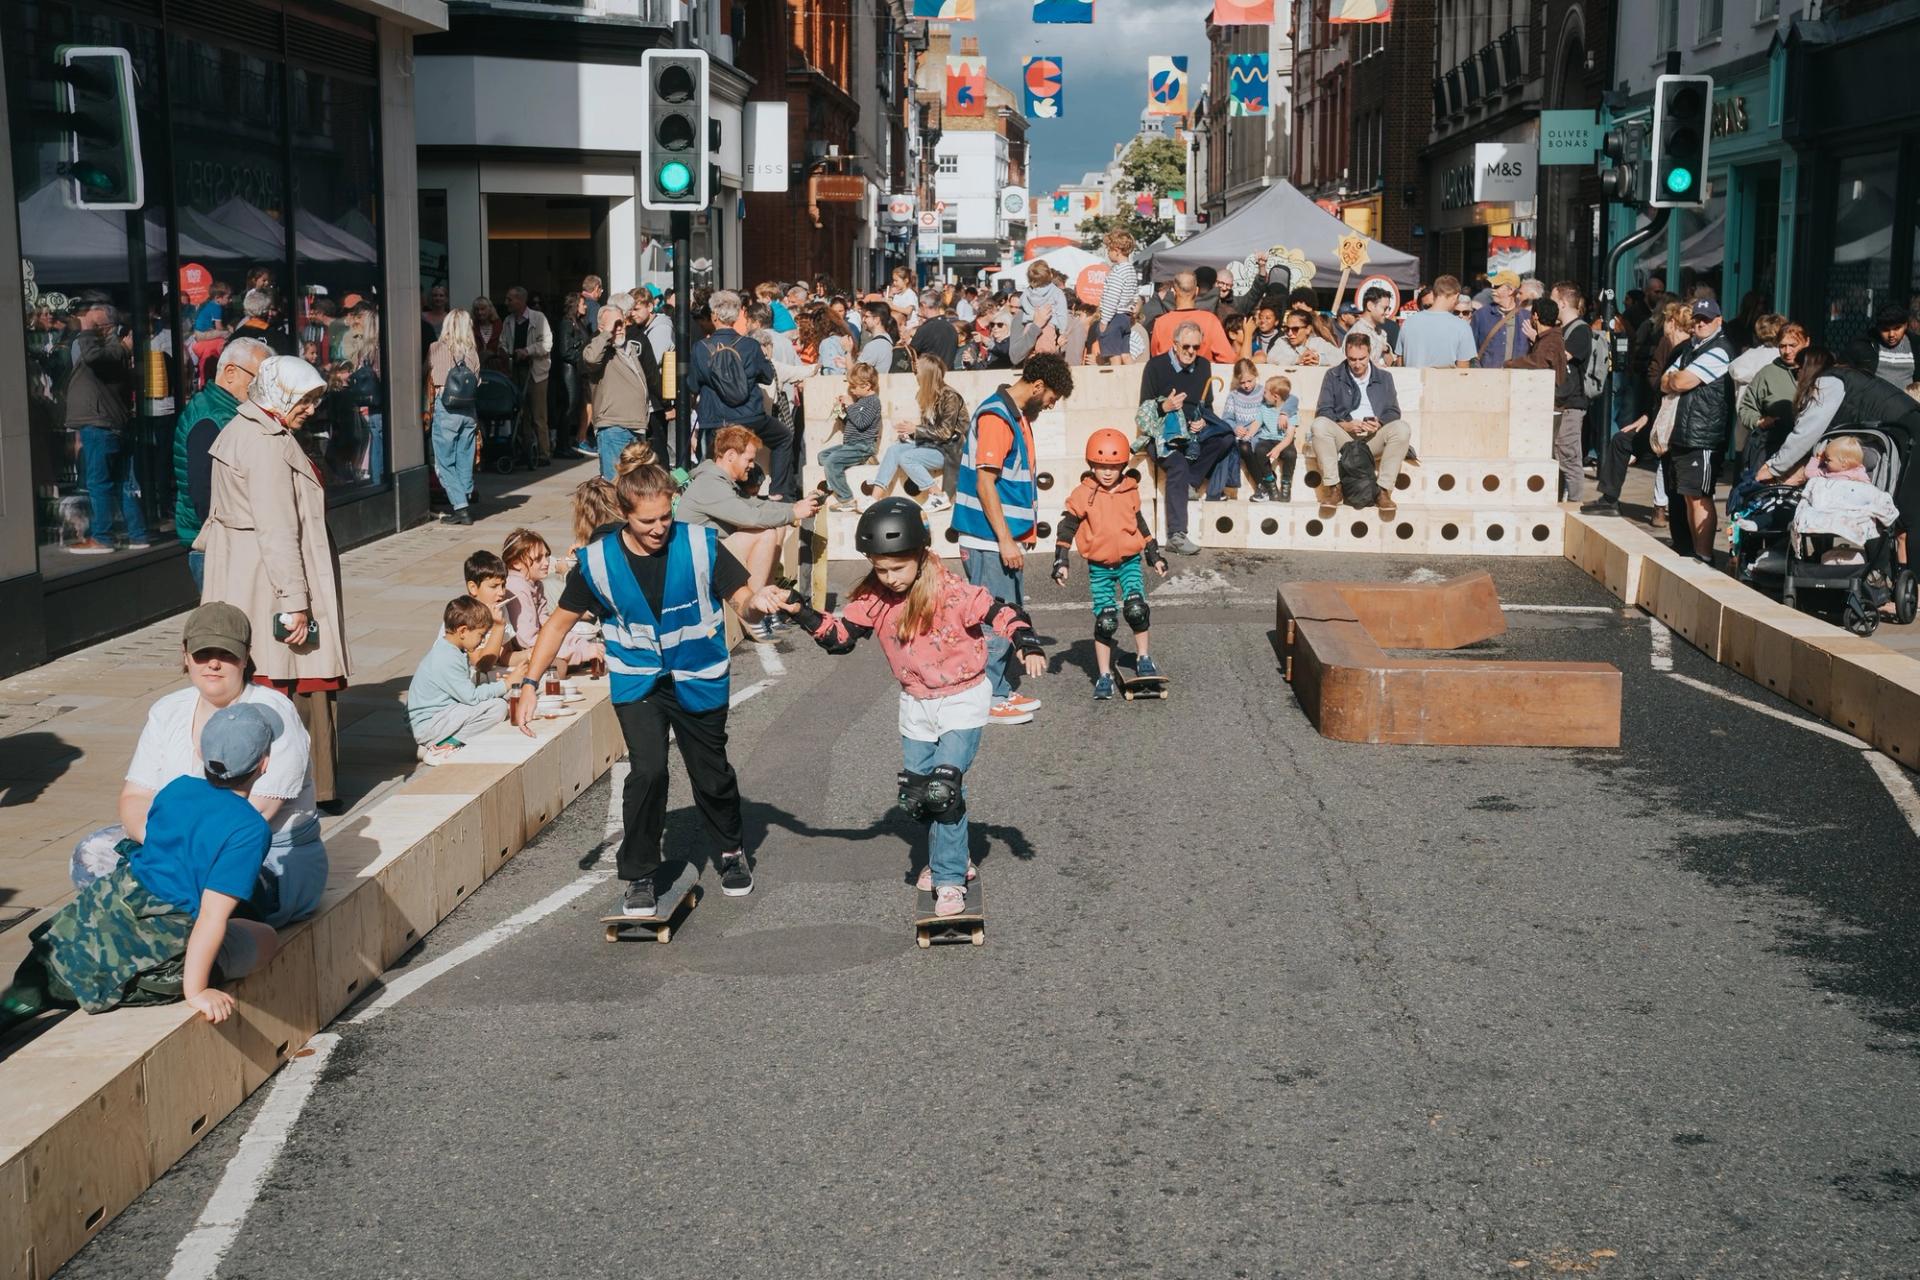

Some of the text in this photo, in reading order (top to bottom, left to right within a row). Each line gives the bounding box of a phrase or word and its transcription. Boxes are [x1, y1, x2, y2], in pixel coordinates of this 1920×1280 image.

[1711, 96, 1748, 138] NAS
[1548, 130, 1589, 138] OLIVER
[1548, 139, 1588, 148] BONAS
[747, 164, 783, 174] EISS
[1487, 161, 1522, 177] M&S
